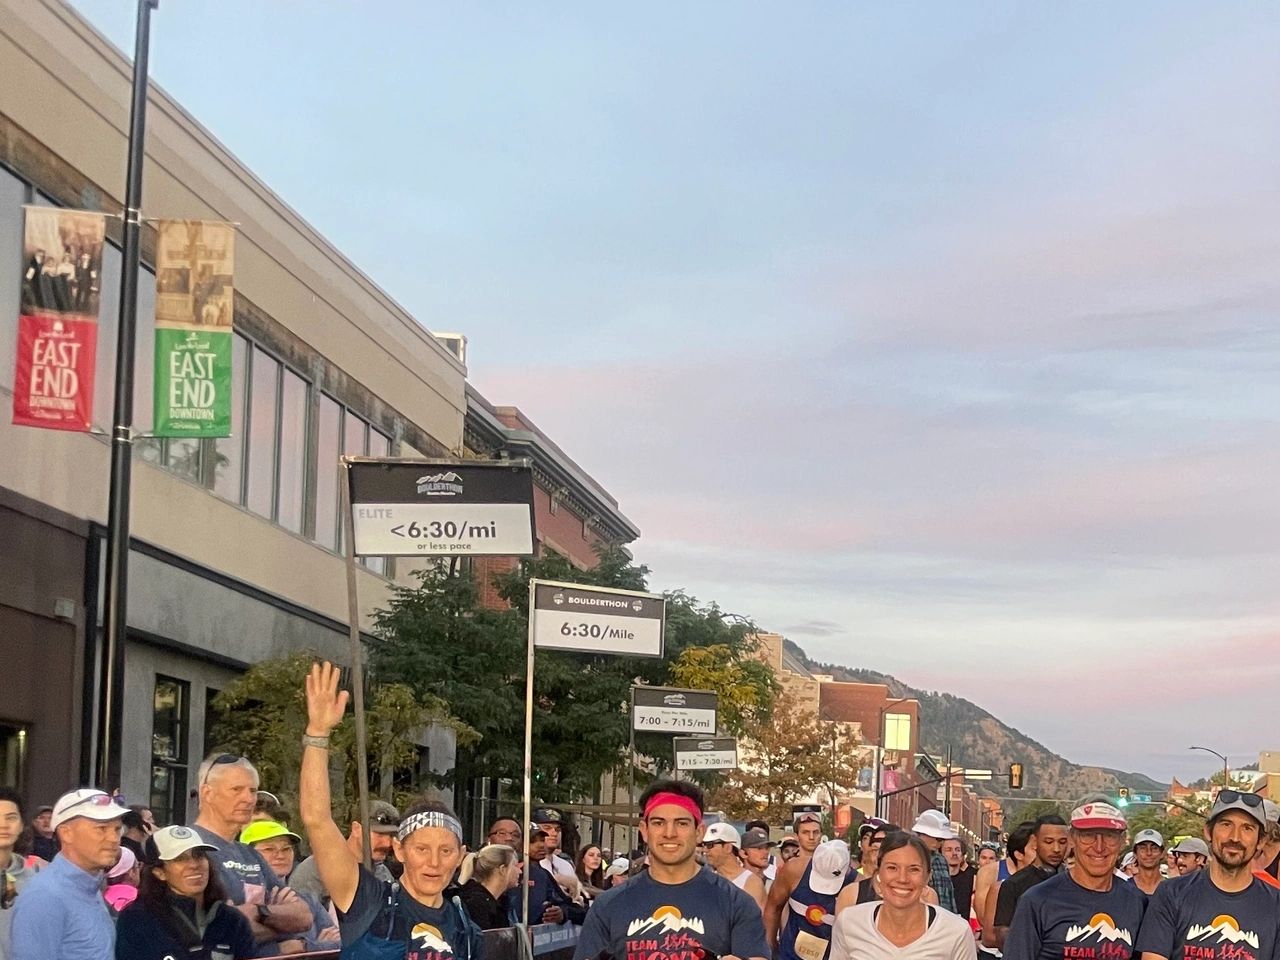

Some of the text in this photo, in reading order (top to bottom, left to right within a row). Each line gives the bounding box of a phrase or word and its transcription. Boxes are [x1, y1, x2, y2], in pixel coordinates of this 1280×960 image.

[33, 339, 81, 369] EAST
[170, 351, 216, 379] EAST
[30, 365, 79, 399] END
[170, 378, 216, 408] END
[169, 407, 215, 420] DOWNTOWN
[358, 508, 393, 519] ELITE
[390, 521, 496, 540] <6:30/mi
[568, 597, 628, 608] BOULDERTHON
[561, 622, 635, 640] 6:30/Mile
[640, 717, 661, 725] 7:00
[672, 718, 710, 728] 7:15/mi
[626, 940, 657, 951] TEAM
[1064, 946, 1095, 958] TEAM
[1184, 945, 1215, 959] TEAM
